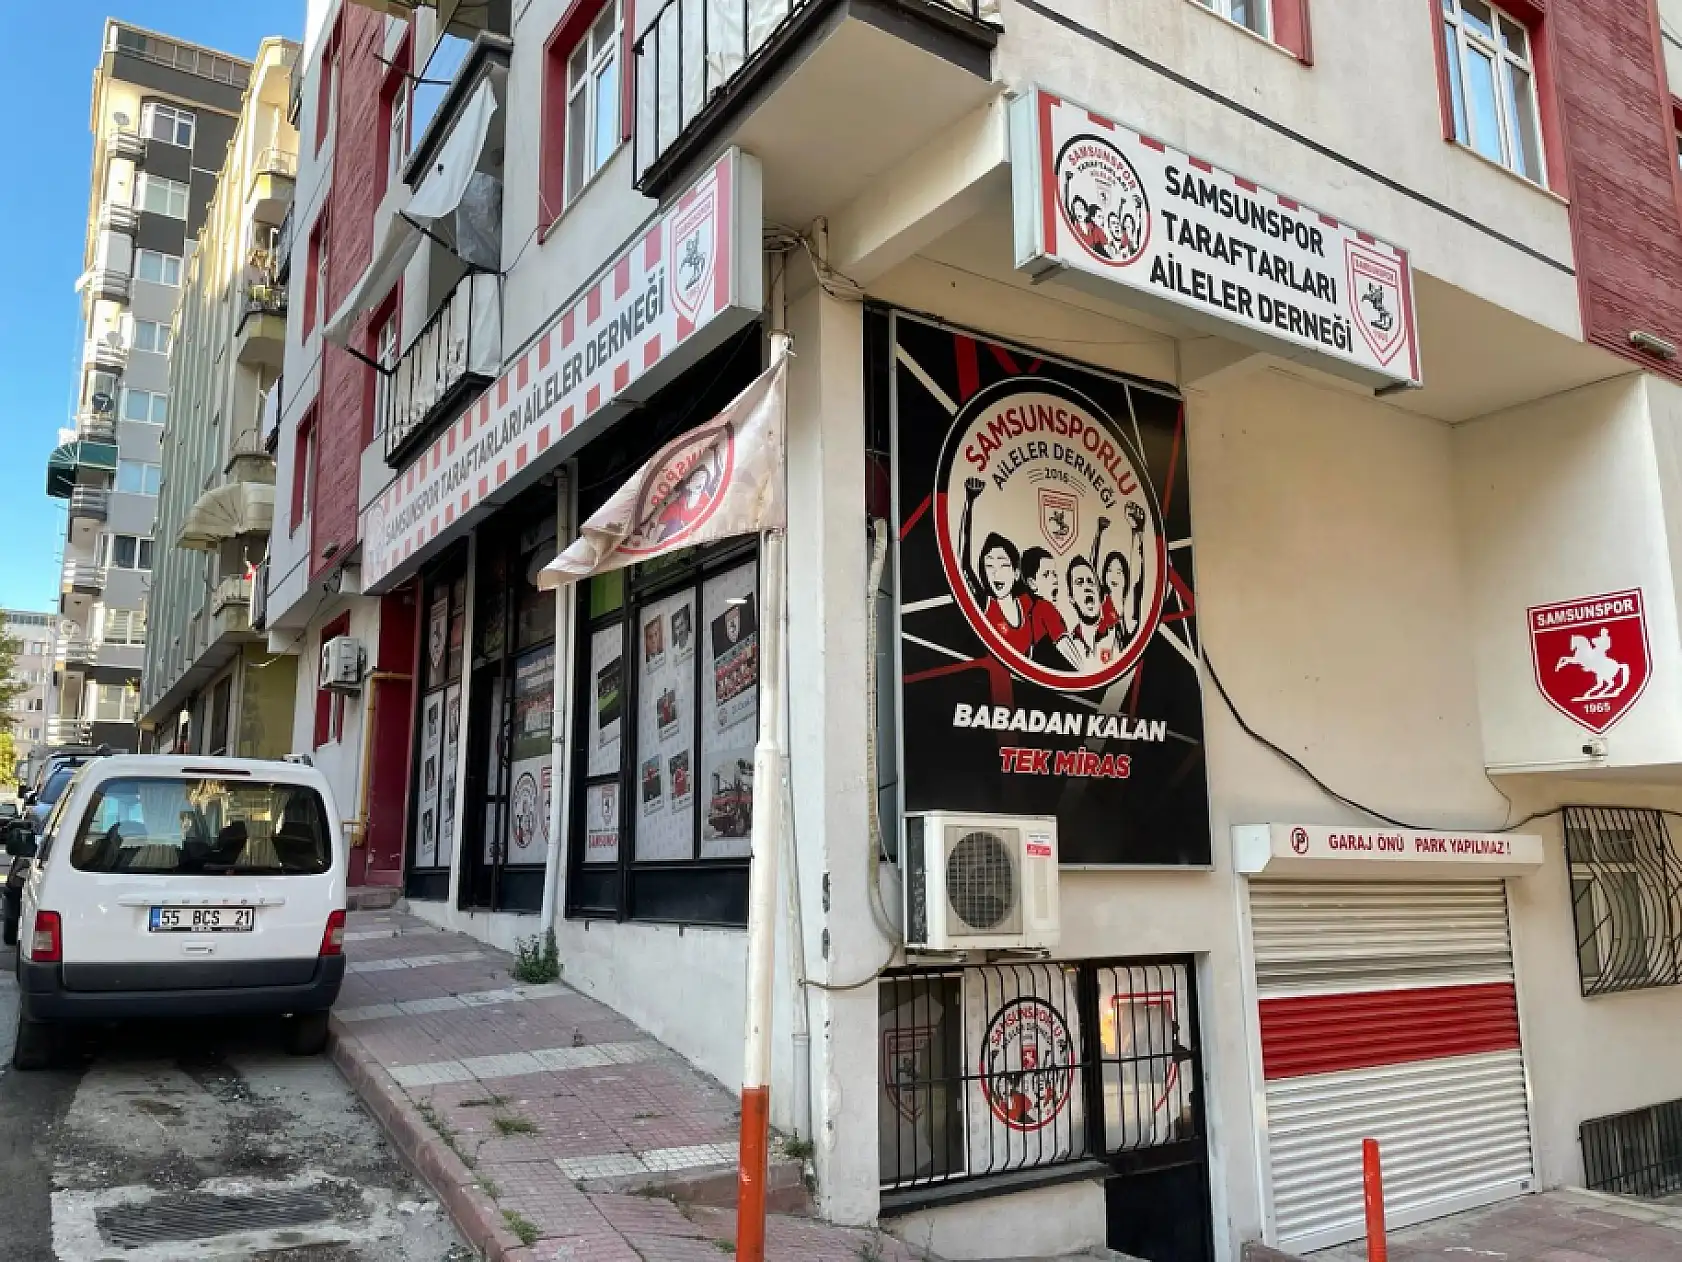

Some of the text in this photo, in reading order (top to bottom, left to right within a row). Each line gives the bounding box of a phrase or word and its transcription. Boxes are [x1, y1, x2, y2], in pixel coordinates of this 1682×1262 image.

[1165, 165, 1325, 258] SAMSUNSPOR
[1161, 209, 1337, 304] TARAFTARLARI
[1150, 252, 1353, 353] AİLELER DERNEĞİ
[441, 404, 521, 499] TARAFTARLARI
[523, 352, 582, 430] AİLELER
[586, 266, 665, 378] DERNEĞİ
[965, 404, 1138, 496] SAMSUNSPORLU
[992, 441, 1117, 509] AİLELER DERNEĞİ
[1536, 599, 1635, 626] SAMSUNSPOR
[953, 703, 1167, 742] BABADAN KALAN
[999, 746, 1132, 779] TEK MİRAS
[1328, 835, 1372, 851] GARAJ
[1377, 833, 1405, 853] ÖNÜ
[1414, 837, 1447, 853] PARK
[161, 910, 181, 926] 55
[193, 910, 220, 926] BCS
[235, 910, 250, 926] 21
